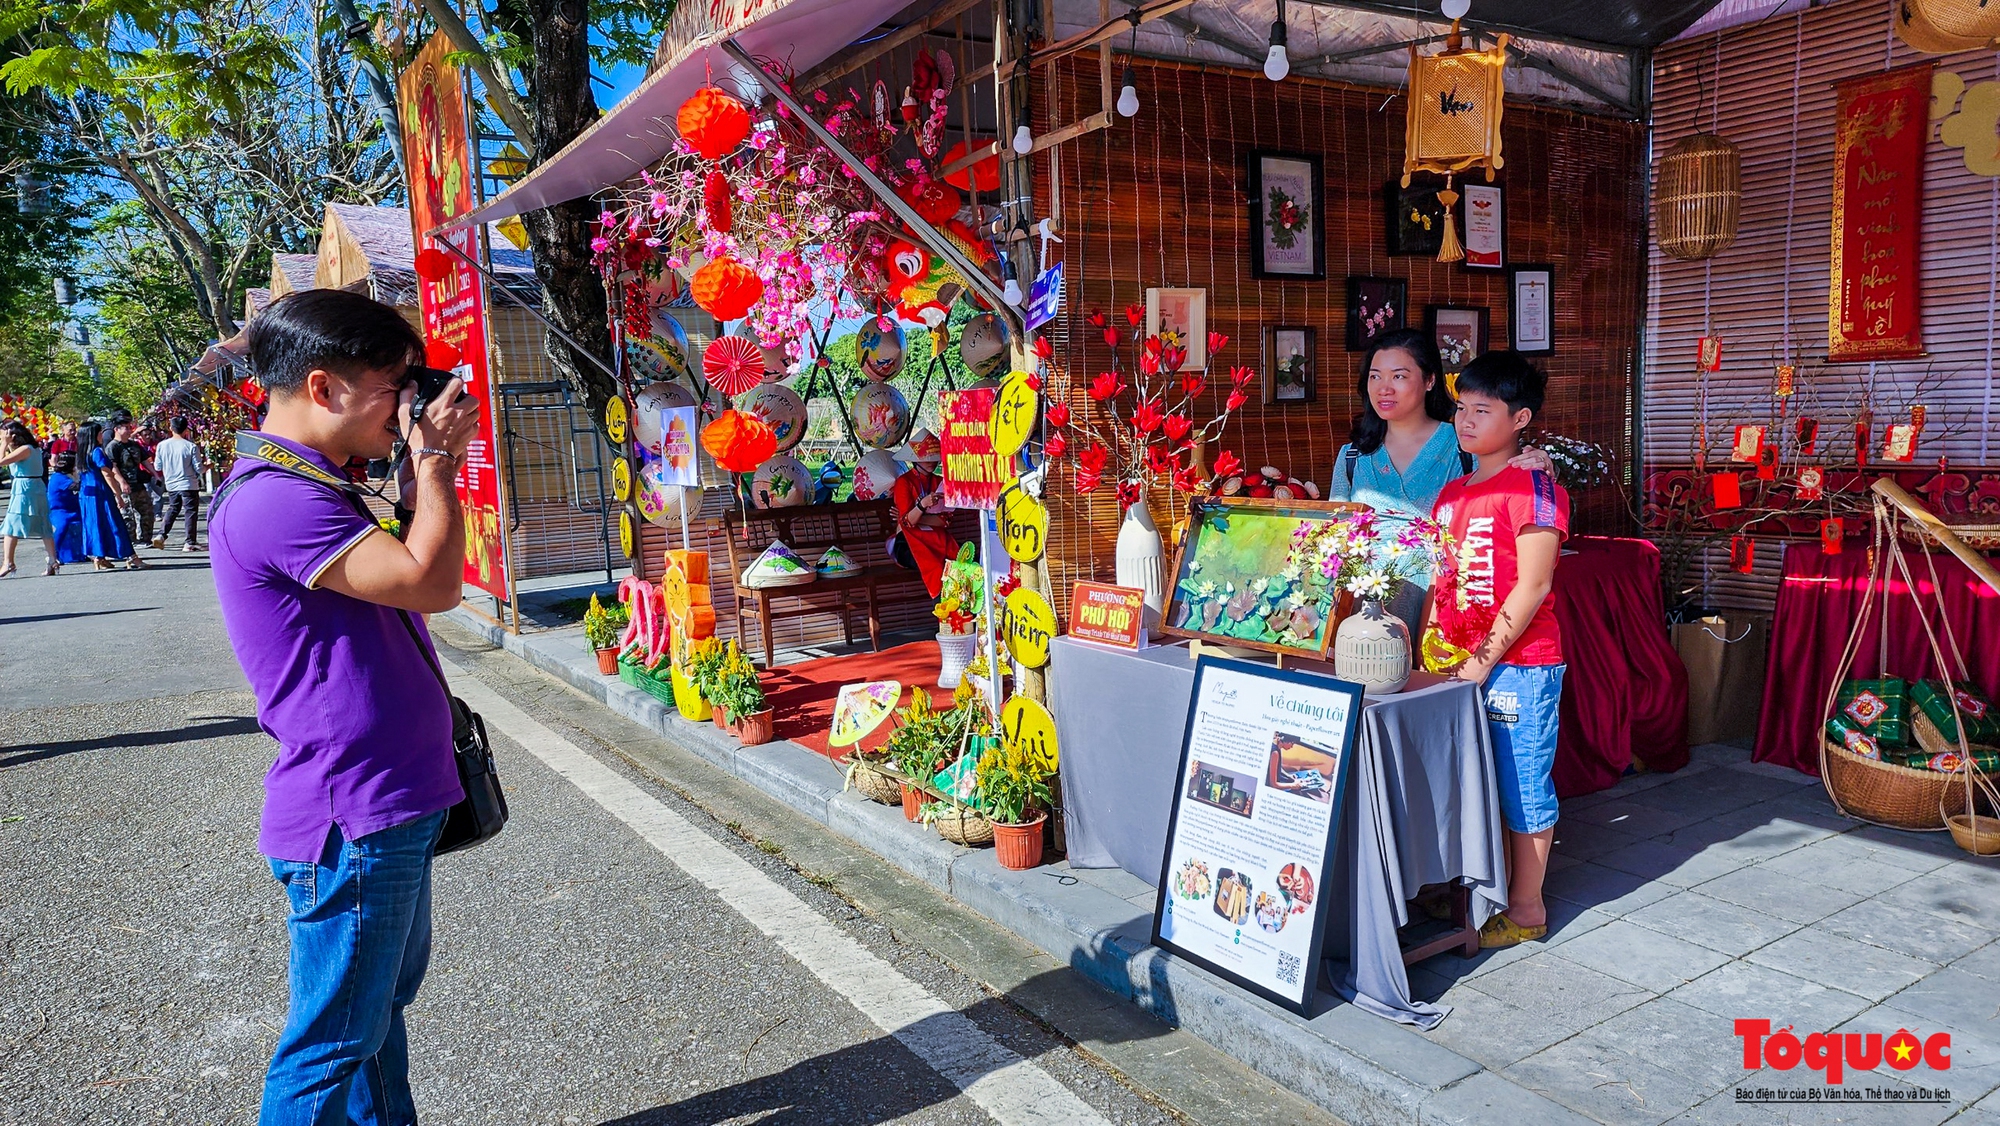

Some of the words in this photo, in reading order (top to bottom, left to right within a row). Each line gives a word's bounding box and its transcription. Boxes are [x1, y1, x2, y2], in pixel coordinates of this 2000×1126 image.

[1268, 250, 1302, 260] VIETNAM
[1866, 316, 1888, 337] về
[993, 376, 1029, 446] Tết
[257, 444, 301, 468] D610
[948, 447, 983, 483] PHƯỜNG
[1465, 516, 1495, 609] NATIVE
[1088, 590, 1125, 605] PHƯỜNG
[1080, 603, 1107, 626] PHÚ
[1107, 607, 1130, 633] HỘI
[1270, 690, 1285, 709] Về
[1286, 700, 1324, 721] chúng
[1326, 706, 1345, 722] tôi
[1488, 713, 1518, 722] CREATED
[1305, 723, 1333, 735] Paperflower
